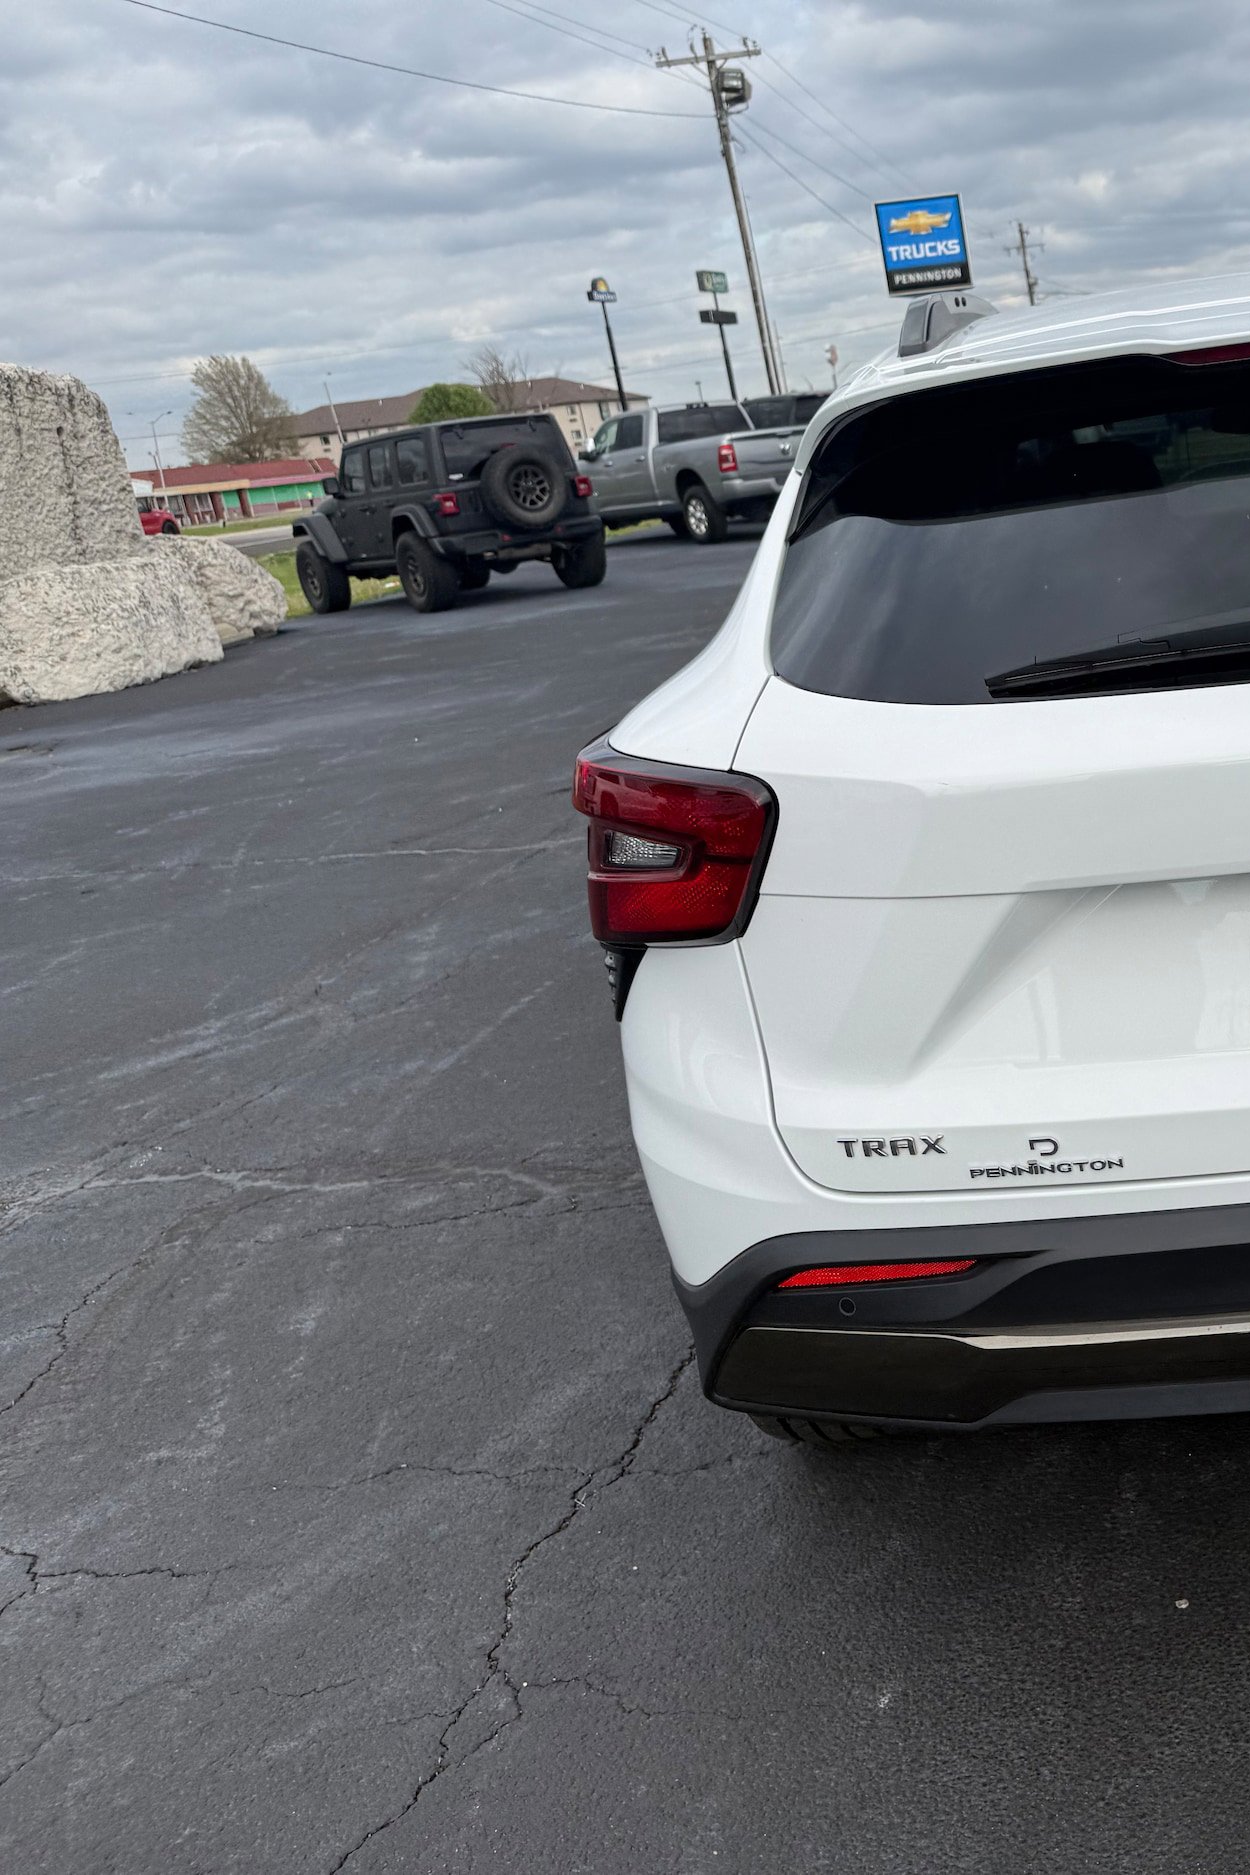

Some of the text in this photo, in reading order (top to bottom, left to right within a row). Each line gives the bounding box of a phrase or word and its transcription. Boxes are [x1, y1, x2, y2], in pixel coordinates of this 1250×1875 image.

[888, 239, 961, 261] TRUCKS
[894, 267, 962, 284] PENNINGTON
[836, 1134, 948, 1158] TRAX
[969, 1156, 1125, 1179] PENNINGTON
